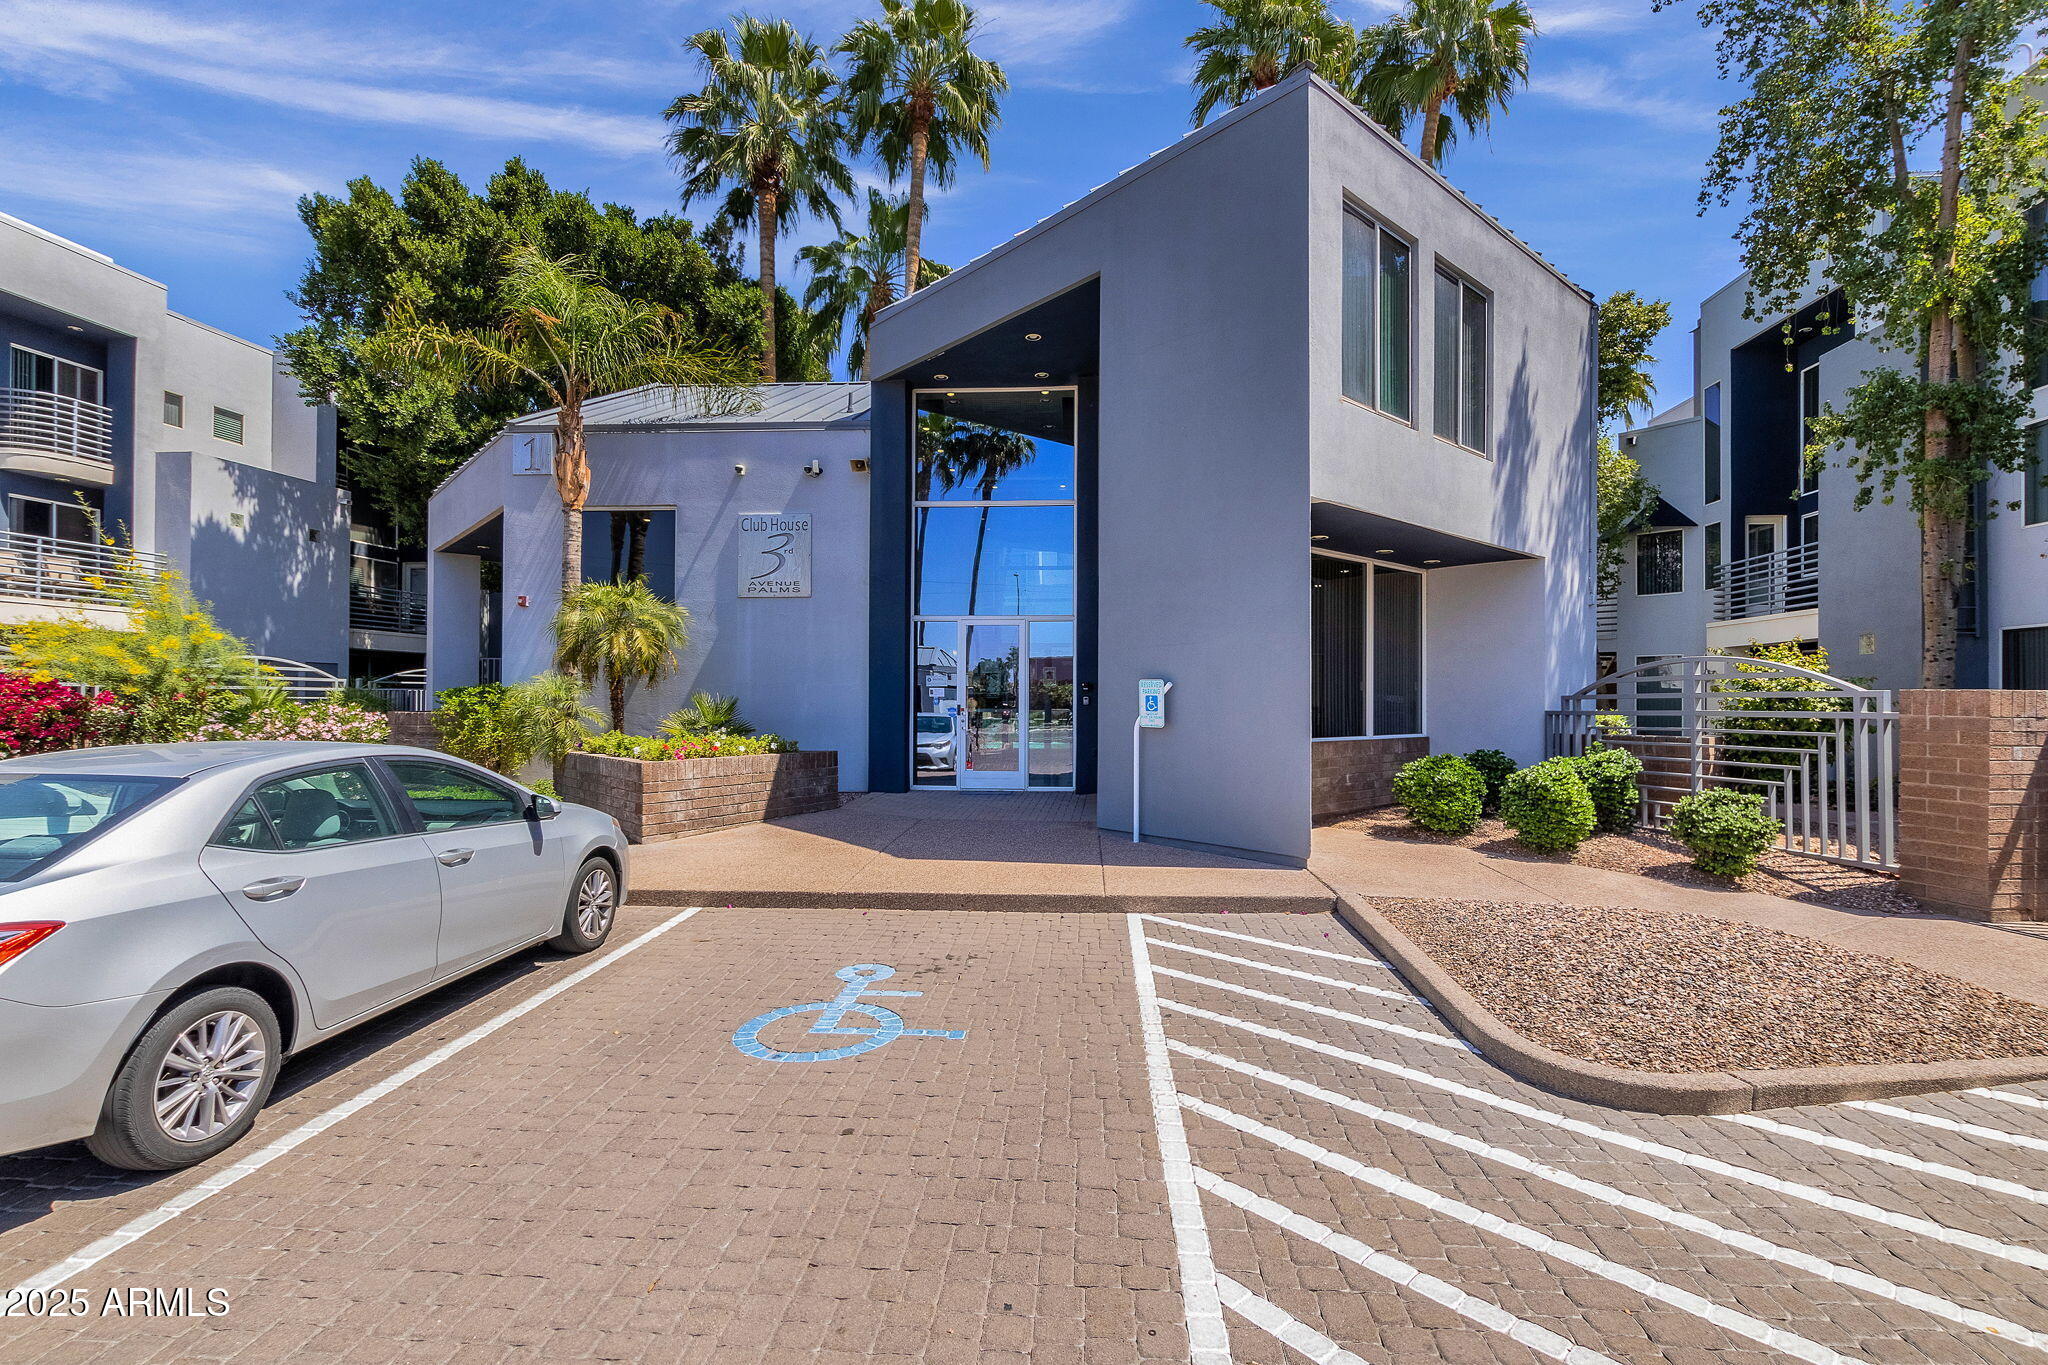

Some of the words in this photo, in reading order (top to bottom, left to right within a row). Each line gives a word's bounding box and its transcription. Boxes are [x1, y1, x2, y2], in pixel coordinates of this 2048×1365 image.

[524, 437, 541, 471] 1
[741, 518, 768, 532] Club
[770, 518, 809, 532] House
